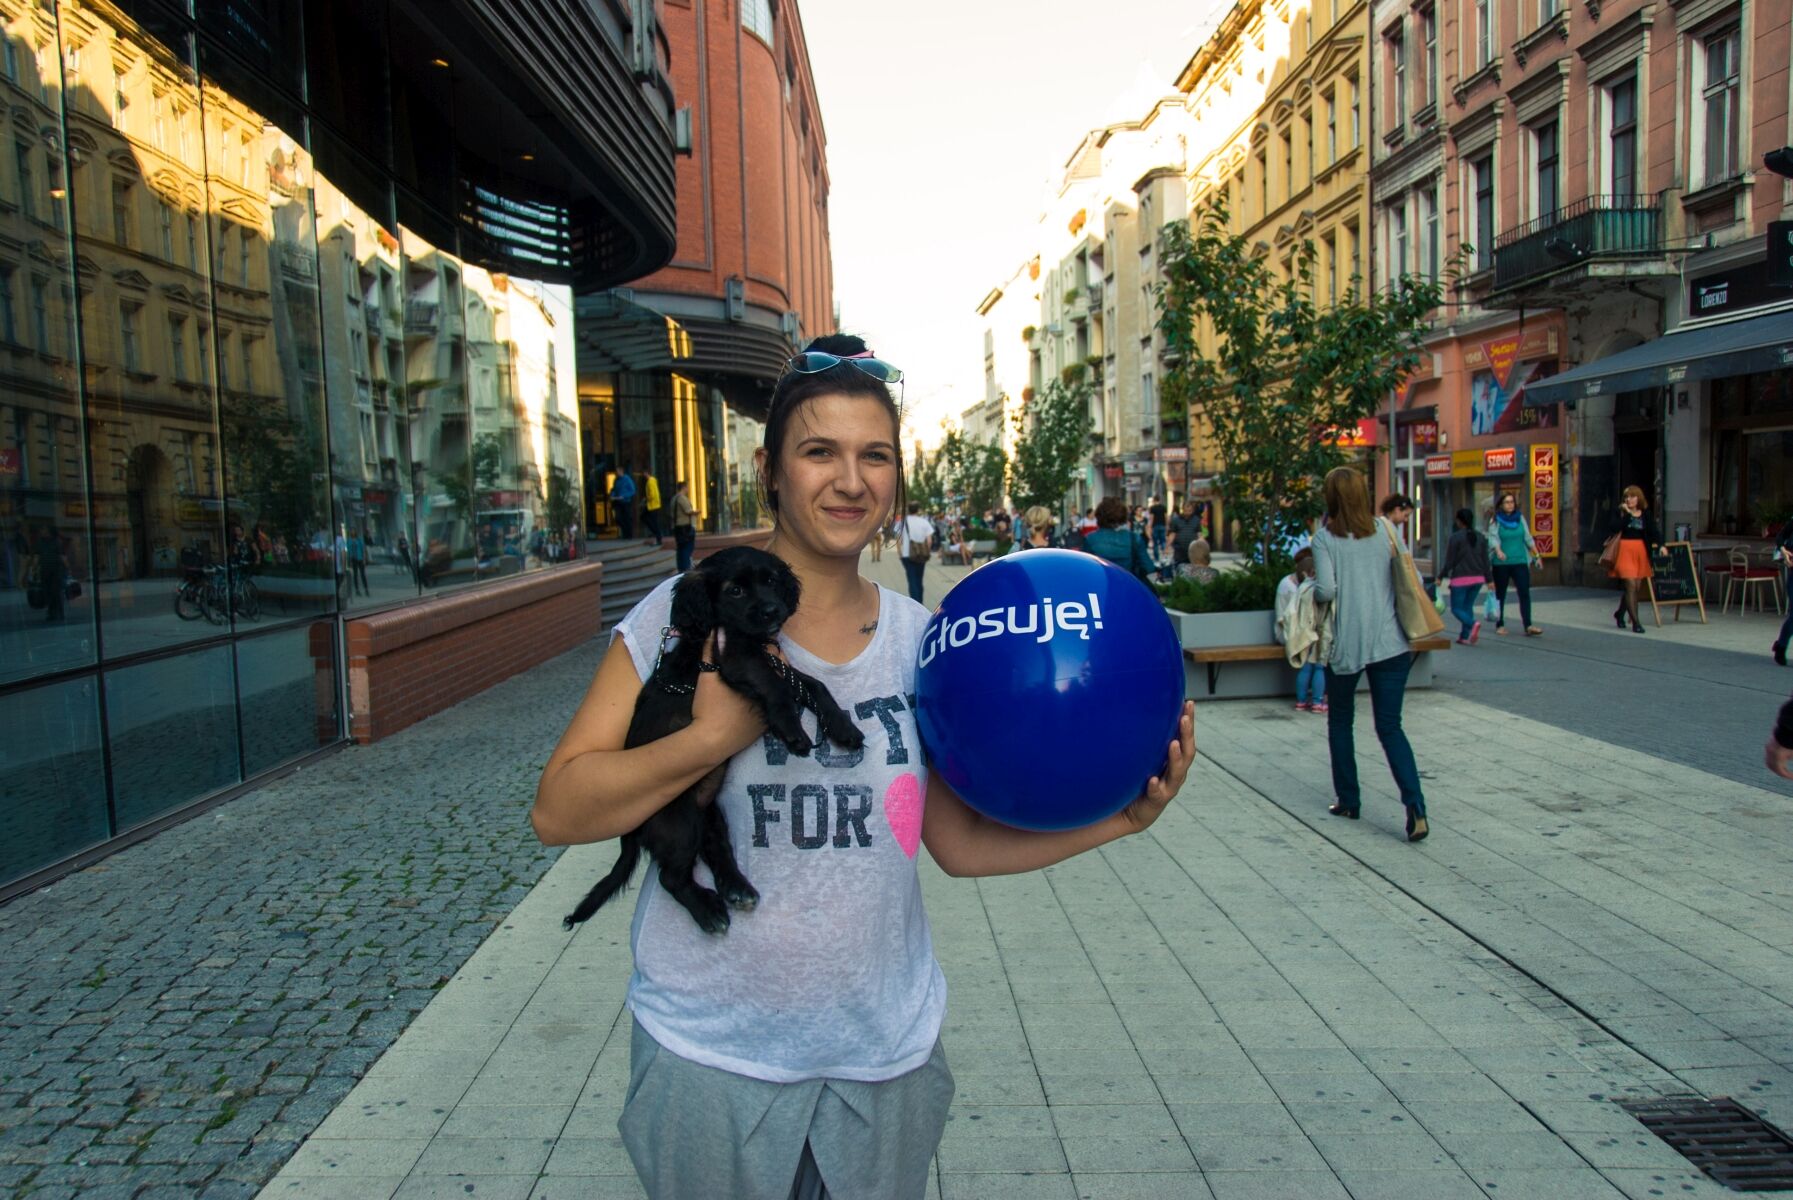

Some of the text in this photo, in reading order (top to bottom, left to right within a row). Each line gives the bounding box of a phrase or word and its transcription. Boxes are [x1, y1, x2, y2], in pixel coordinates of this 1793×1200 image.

[1701, 290, 1727, 309] LORENZO
[918, 593, 1103, 669] Głosuję!
[747, 784, 873, 849] FOR
